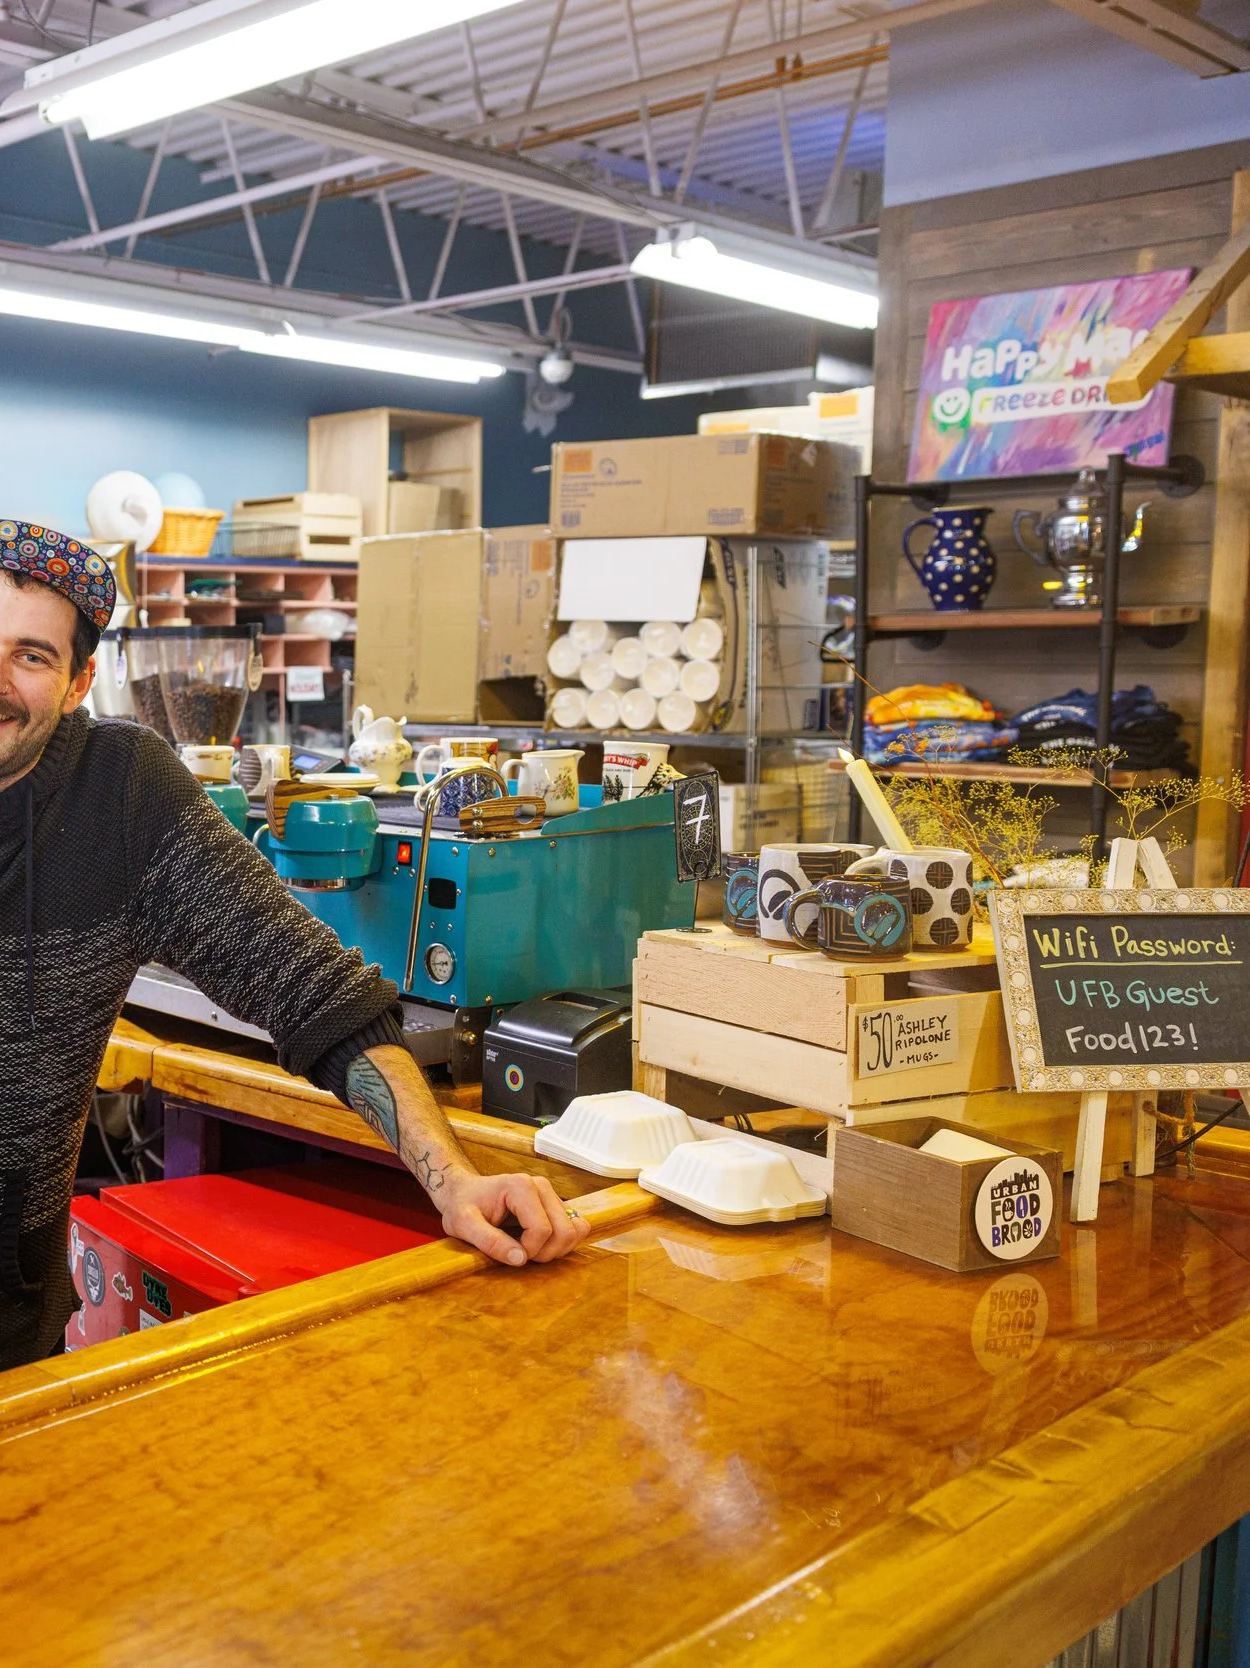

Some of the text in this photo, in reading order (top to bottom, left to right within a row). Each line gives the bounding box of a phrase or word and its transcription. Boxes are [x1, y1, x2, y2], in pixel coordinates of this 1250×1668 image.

[617, 755, 638, 768] WHIP
[682, 794, 710, 845] 7
[1033, 925, 1237, 959] Wifi Password:
[1054, 979, 1220, 1012] UFB Guest
[895, 1029, 951, 1051] RIPOLONE
[897, 1014, 948, 1037] ASHLEY
[992, 1179, 1039, 1199] URBAN
[991, 1193, 1041, 1226] FOOD
[991, 1217, 1042, 1248] BROOD
